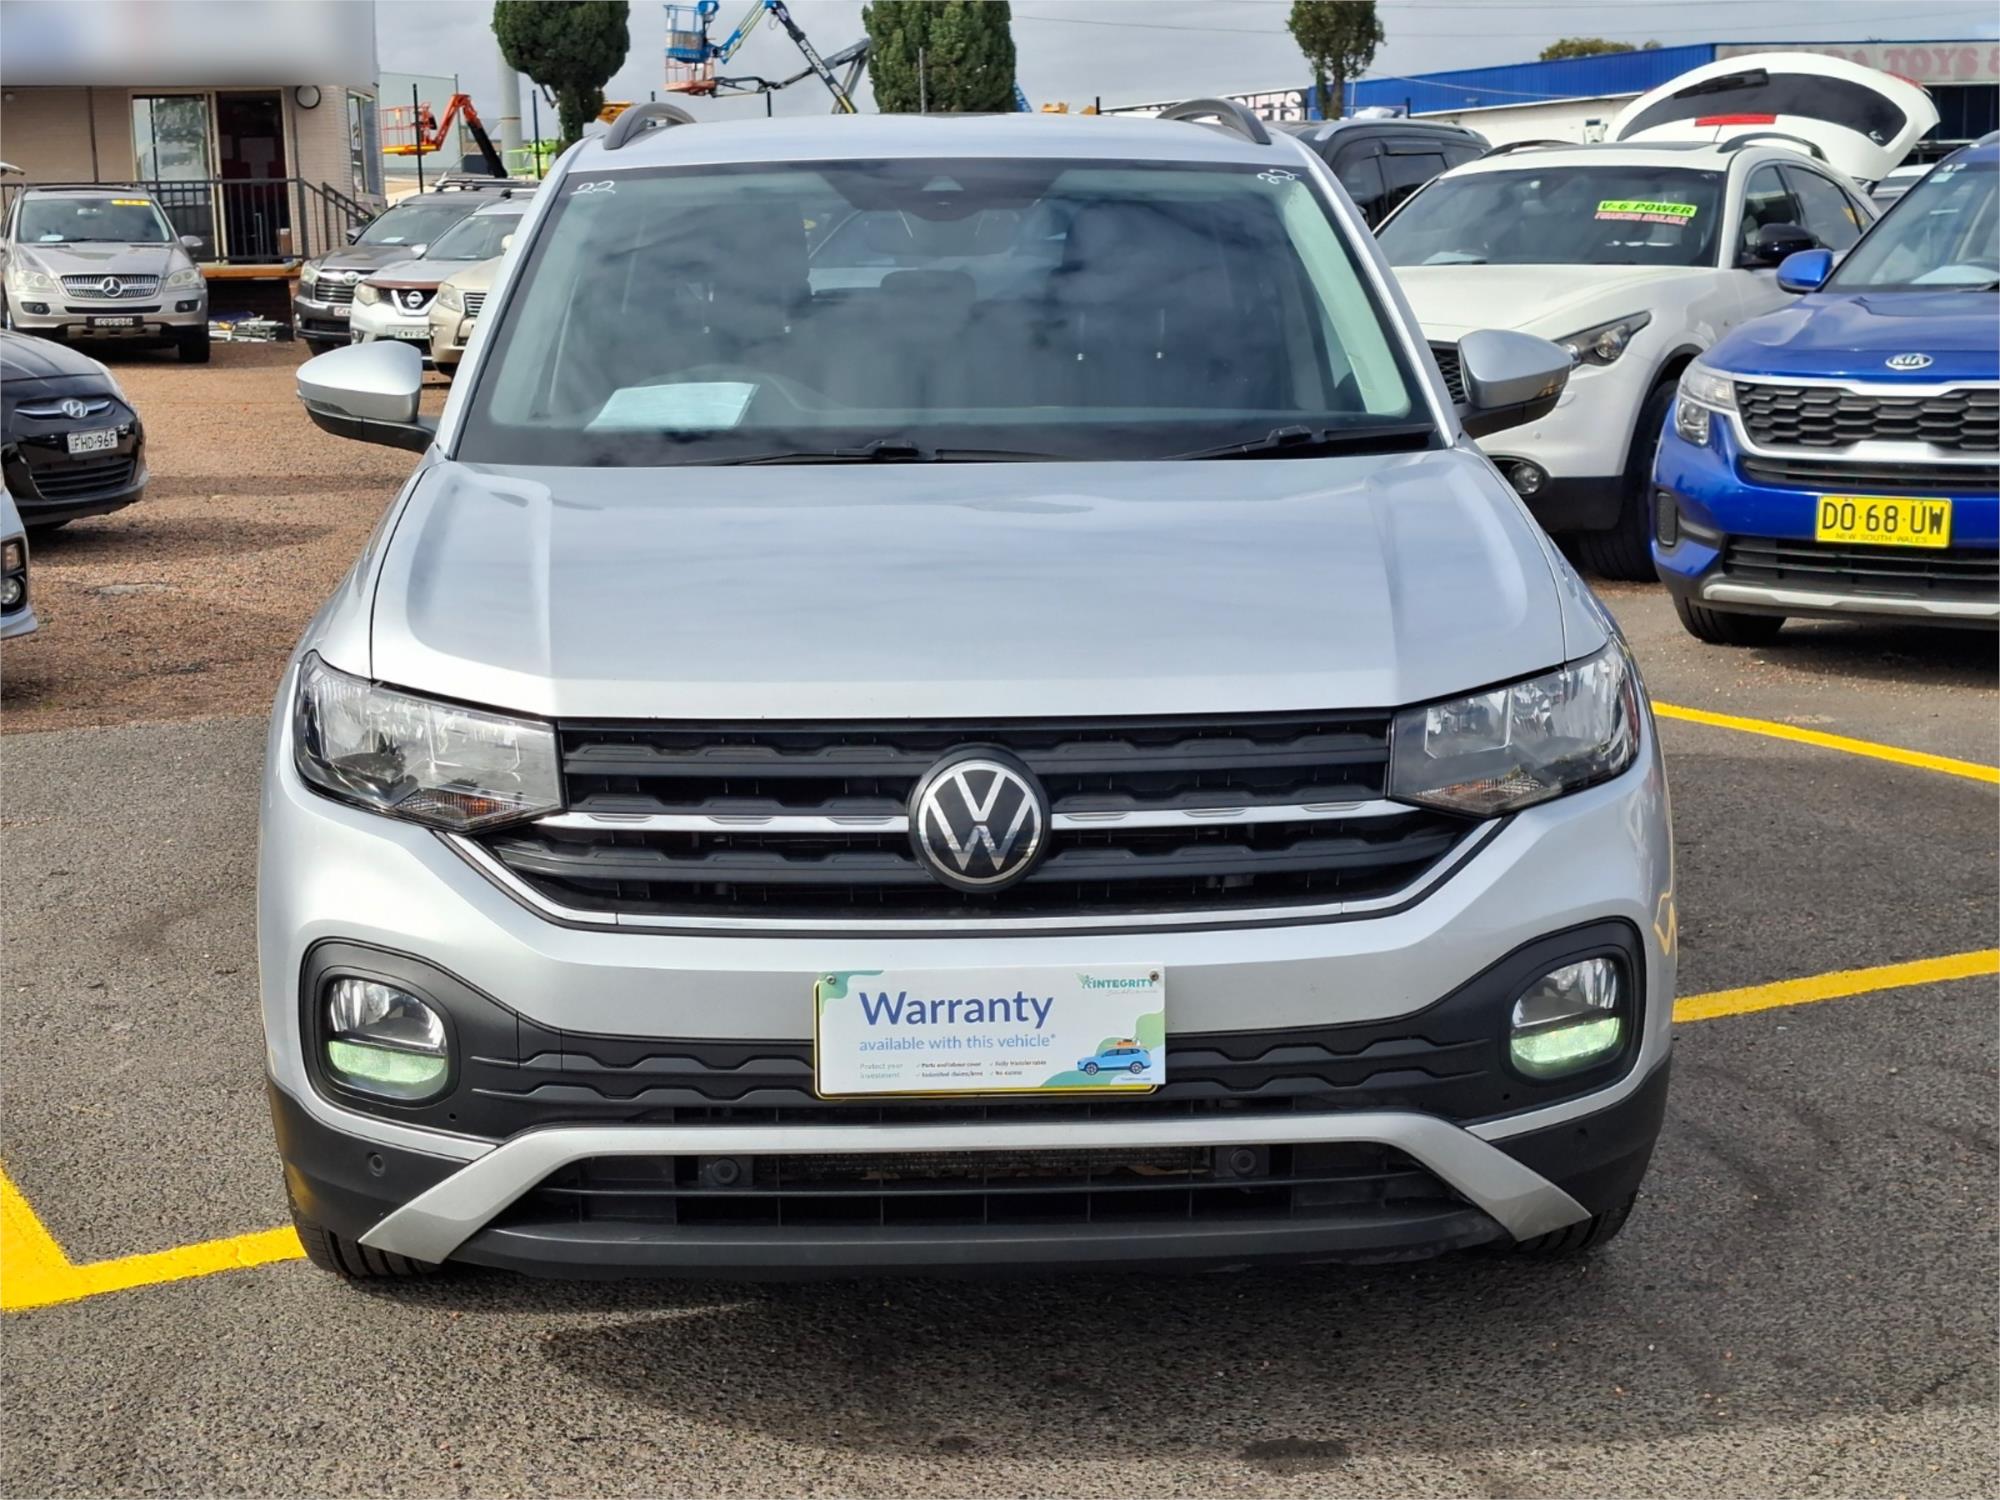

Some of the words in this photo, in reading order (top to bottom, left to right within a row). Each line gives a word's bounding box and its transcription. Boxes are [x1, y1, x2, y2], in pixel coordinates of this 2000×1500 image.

[1884, 48, 1979, 77] TOYS
[1601, 202, 1629, 210] V-6
[1633, 203, 1694, 214] POWER
[1836, 532, 1857, 540] NEW
[1860, 534, 1892, 542] SOUTH
[1092, 978, 1154, 989] INTEGRITY
[858, 990, 1054, 1030] Warranty
[859, 1036, 925, 1051] available
[928, 1035, 962, 1049] with
[966, 1035, 994, 1049] this
